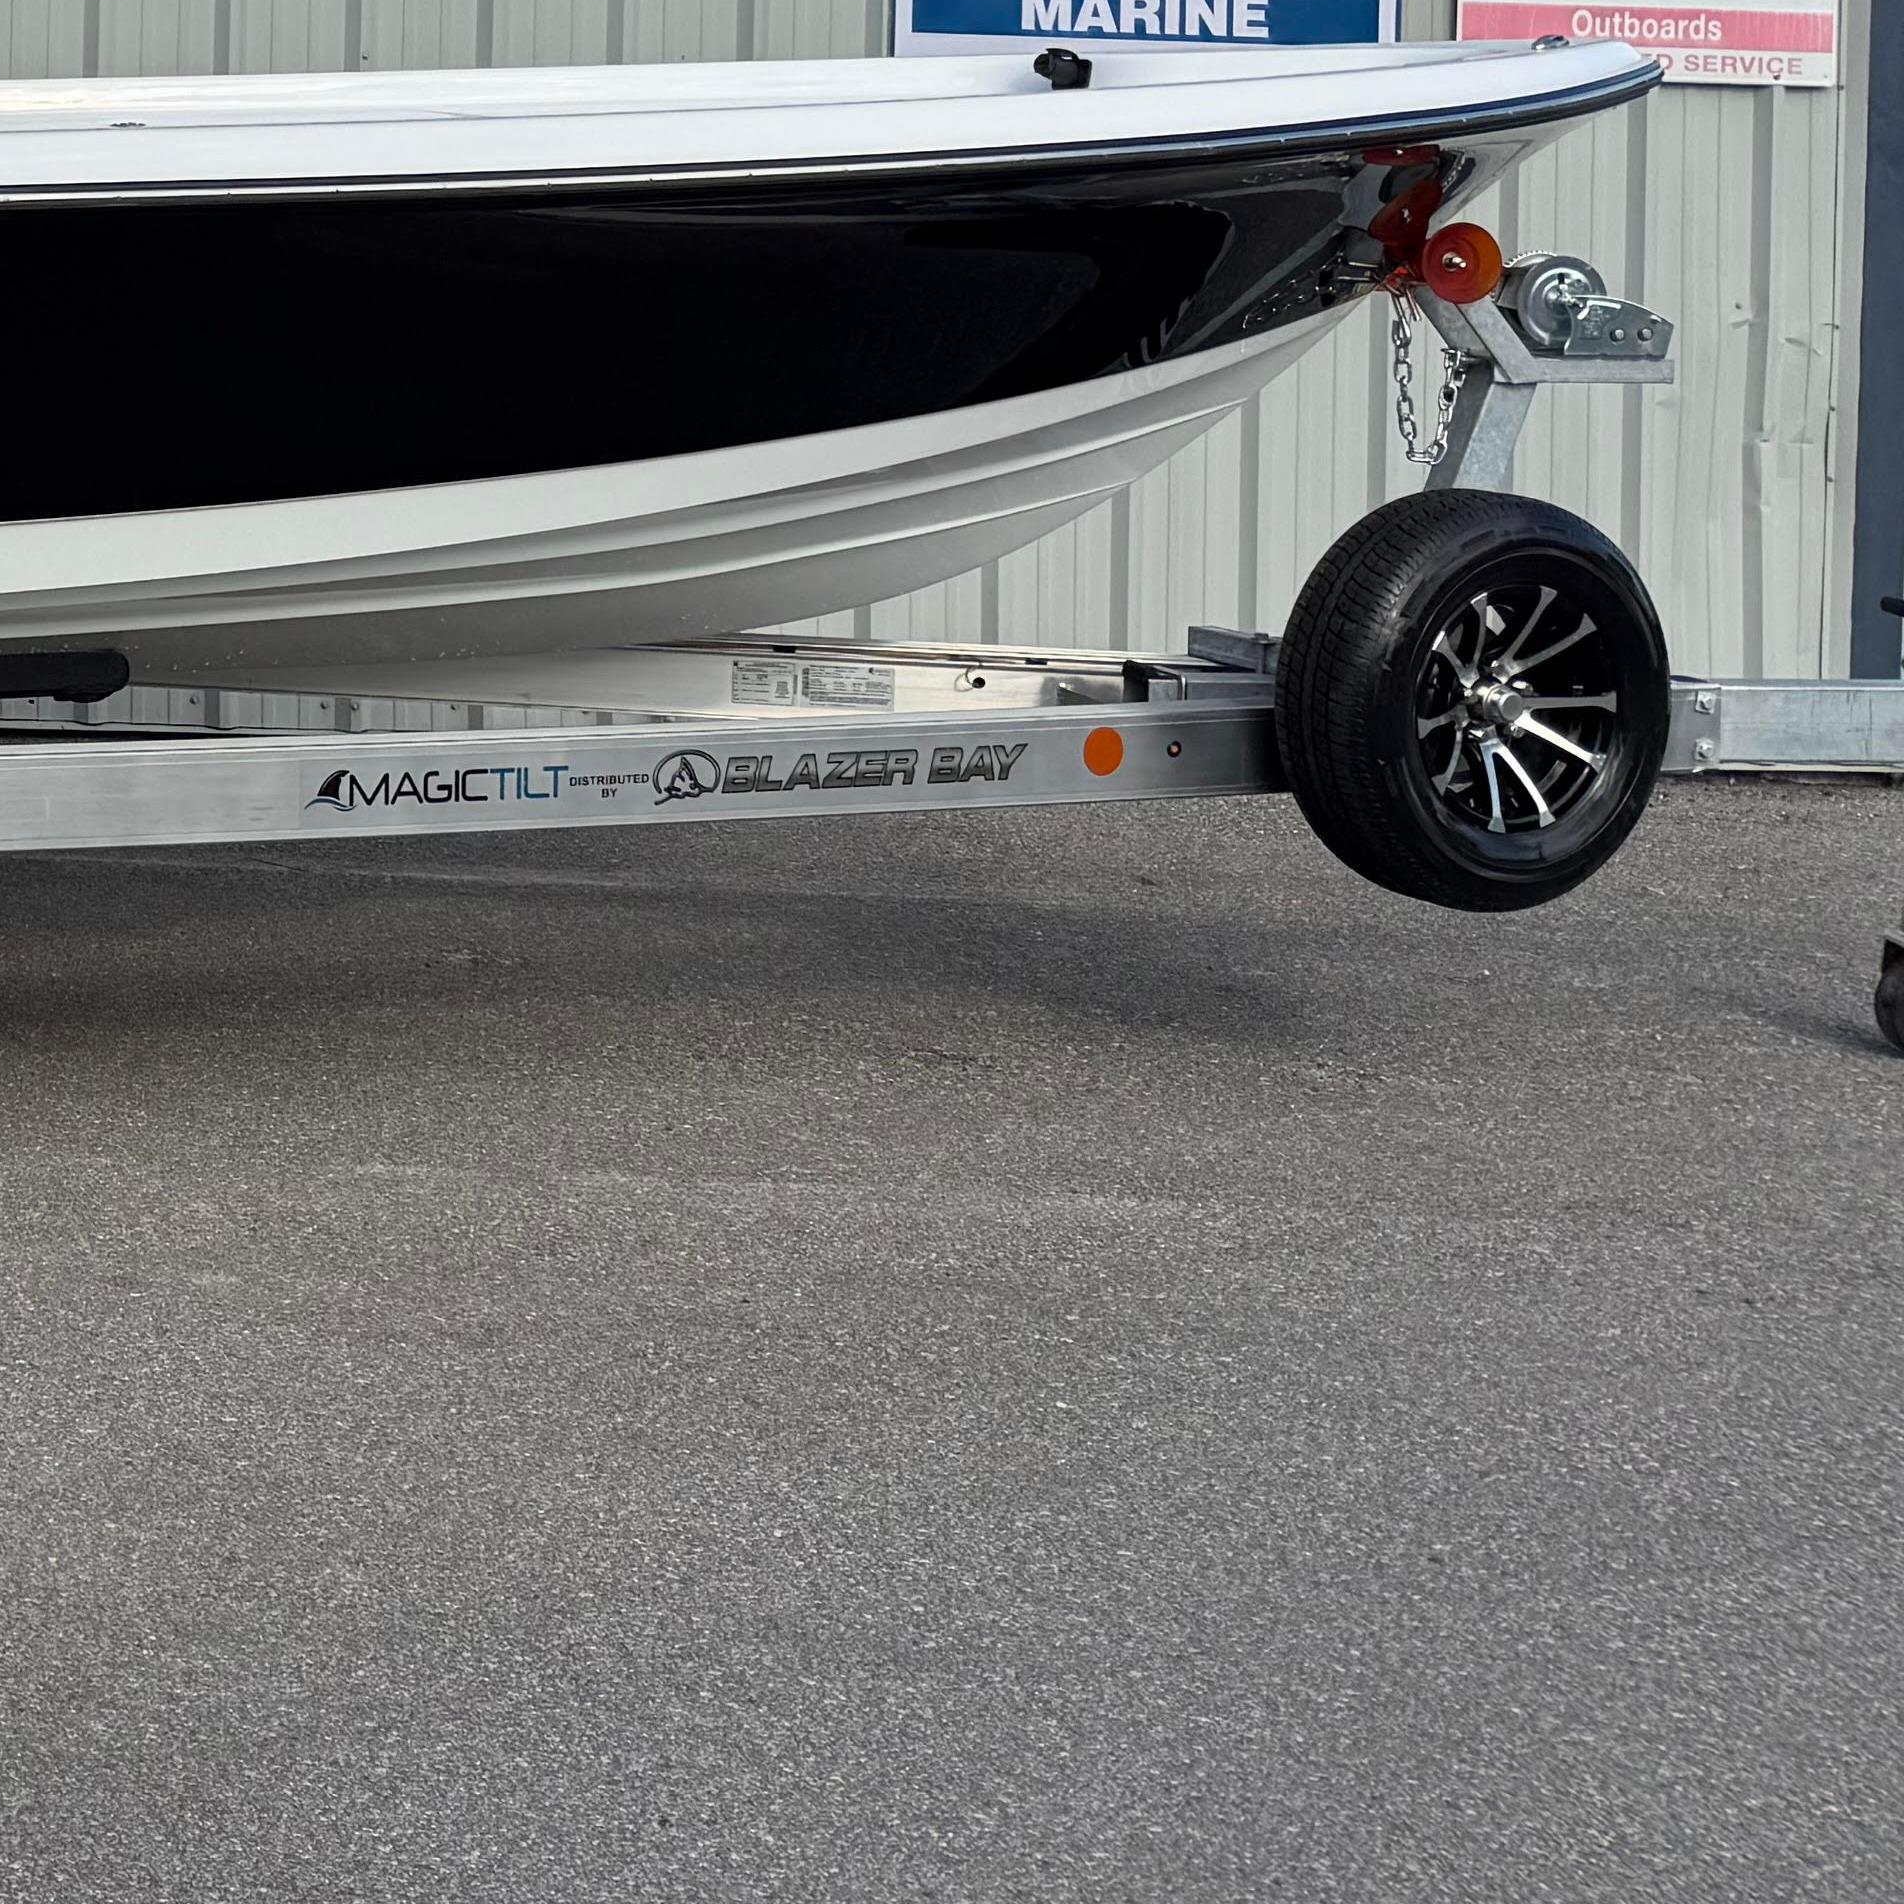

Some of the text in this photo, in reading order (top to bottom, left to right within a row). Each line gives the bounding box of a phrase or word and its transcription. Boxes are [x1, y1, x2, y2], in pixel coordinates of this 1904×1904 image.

[1572, 8, 1723, 42] Outboards
[1683, 53, 1804, 75] SERVICE
[348, 765, 650, 807] MAGICTILT DISTRIBUTED
[721, 743, 1029, 795] BLAZER BAY
[601, 787, 618, 799] BY
